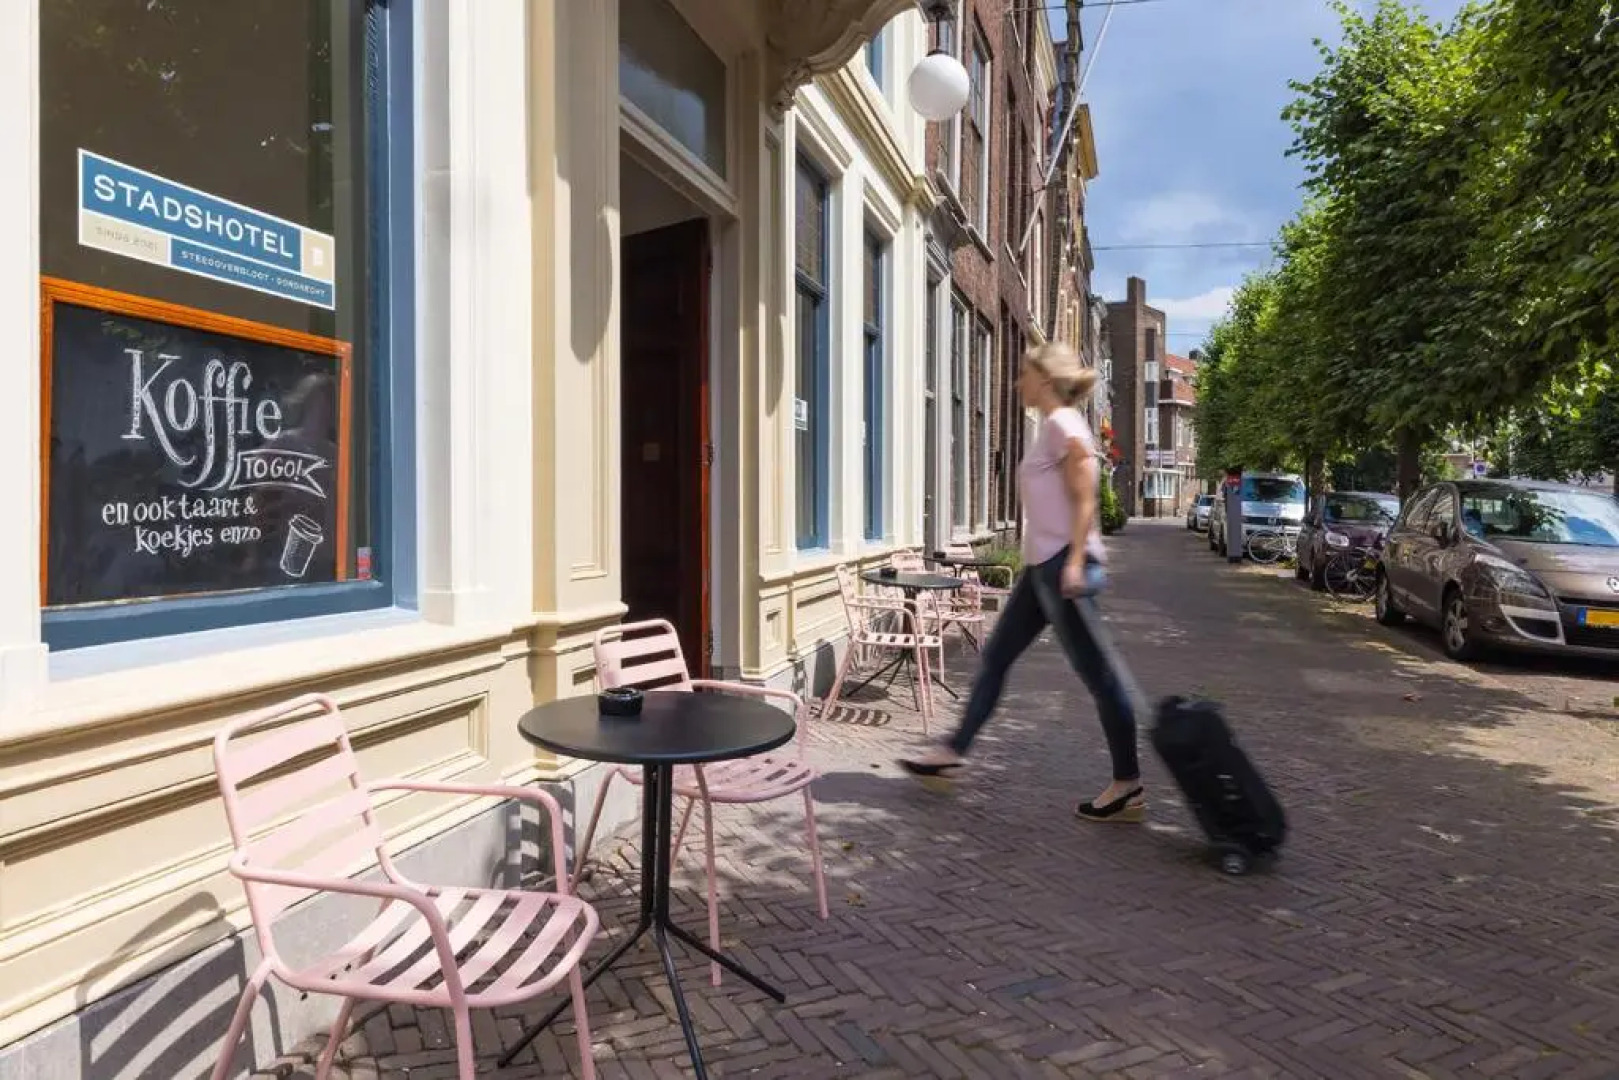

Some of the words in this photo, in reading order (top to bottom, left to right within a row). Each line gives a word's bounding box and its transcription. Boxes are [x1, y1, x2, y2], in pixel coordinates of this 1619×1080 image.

[93, 173, 294, 258] STADSHOTEL
[121, 348, 283, 490] Koffie
[102, 502, 129, 525] en
[133, 495, 176, 521] ook
[178, 493, 242, 520] taart
[243, 495, 259, 515] &
[134, 524, 214, 558] koekjes
[220, 526, 262, 544] enzo
